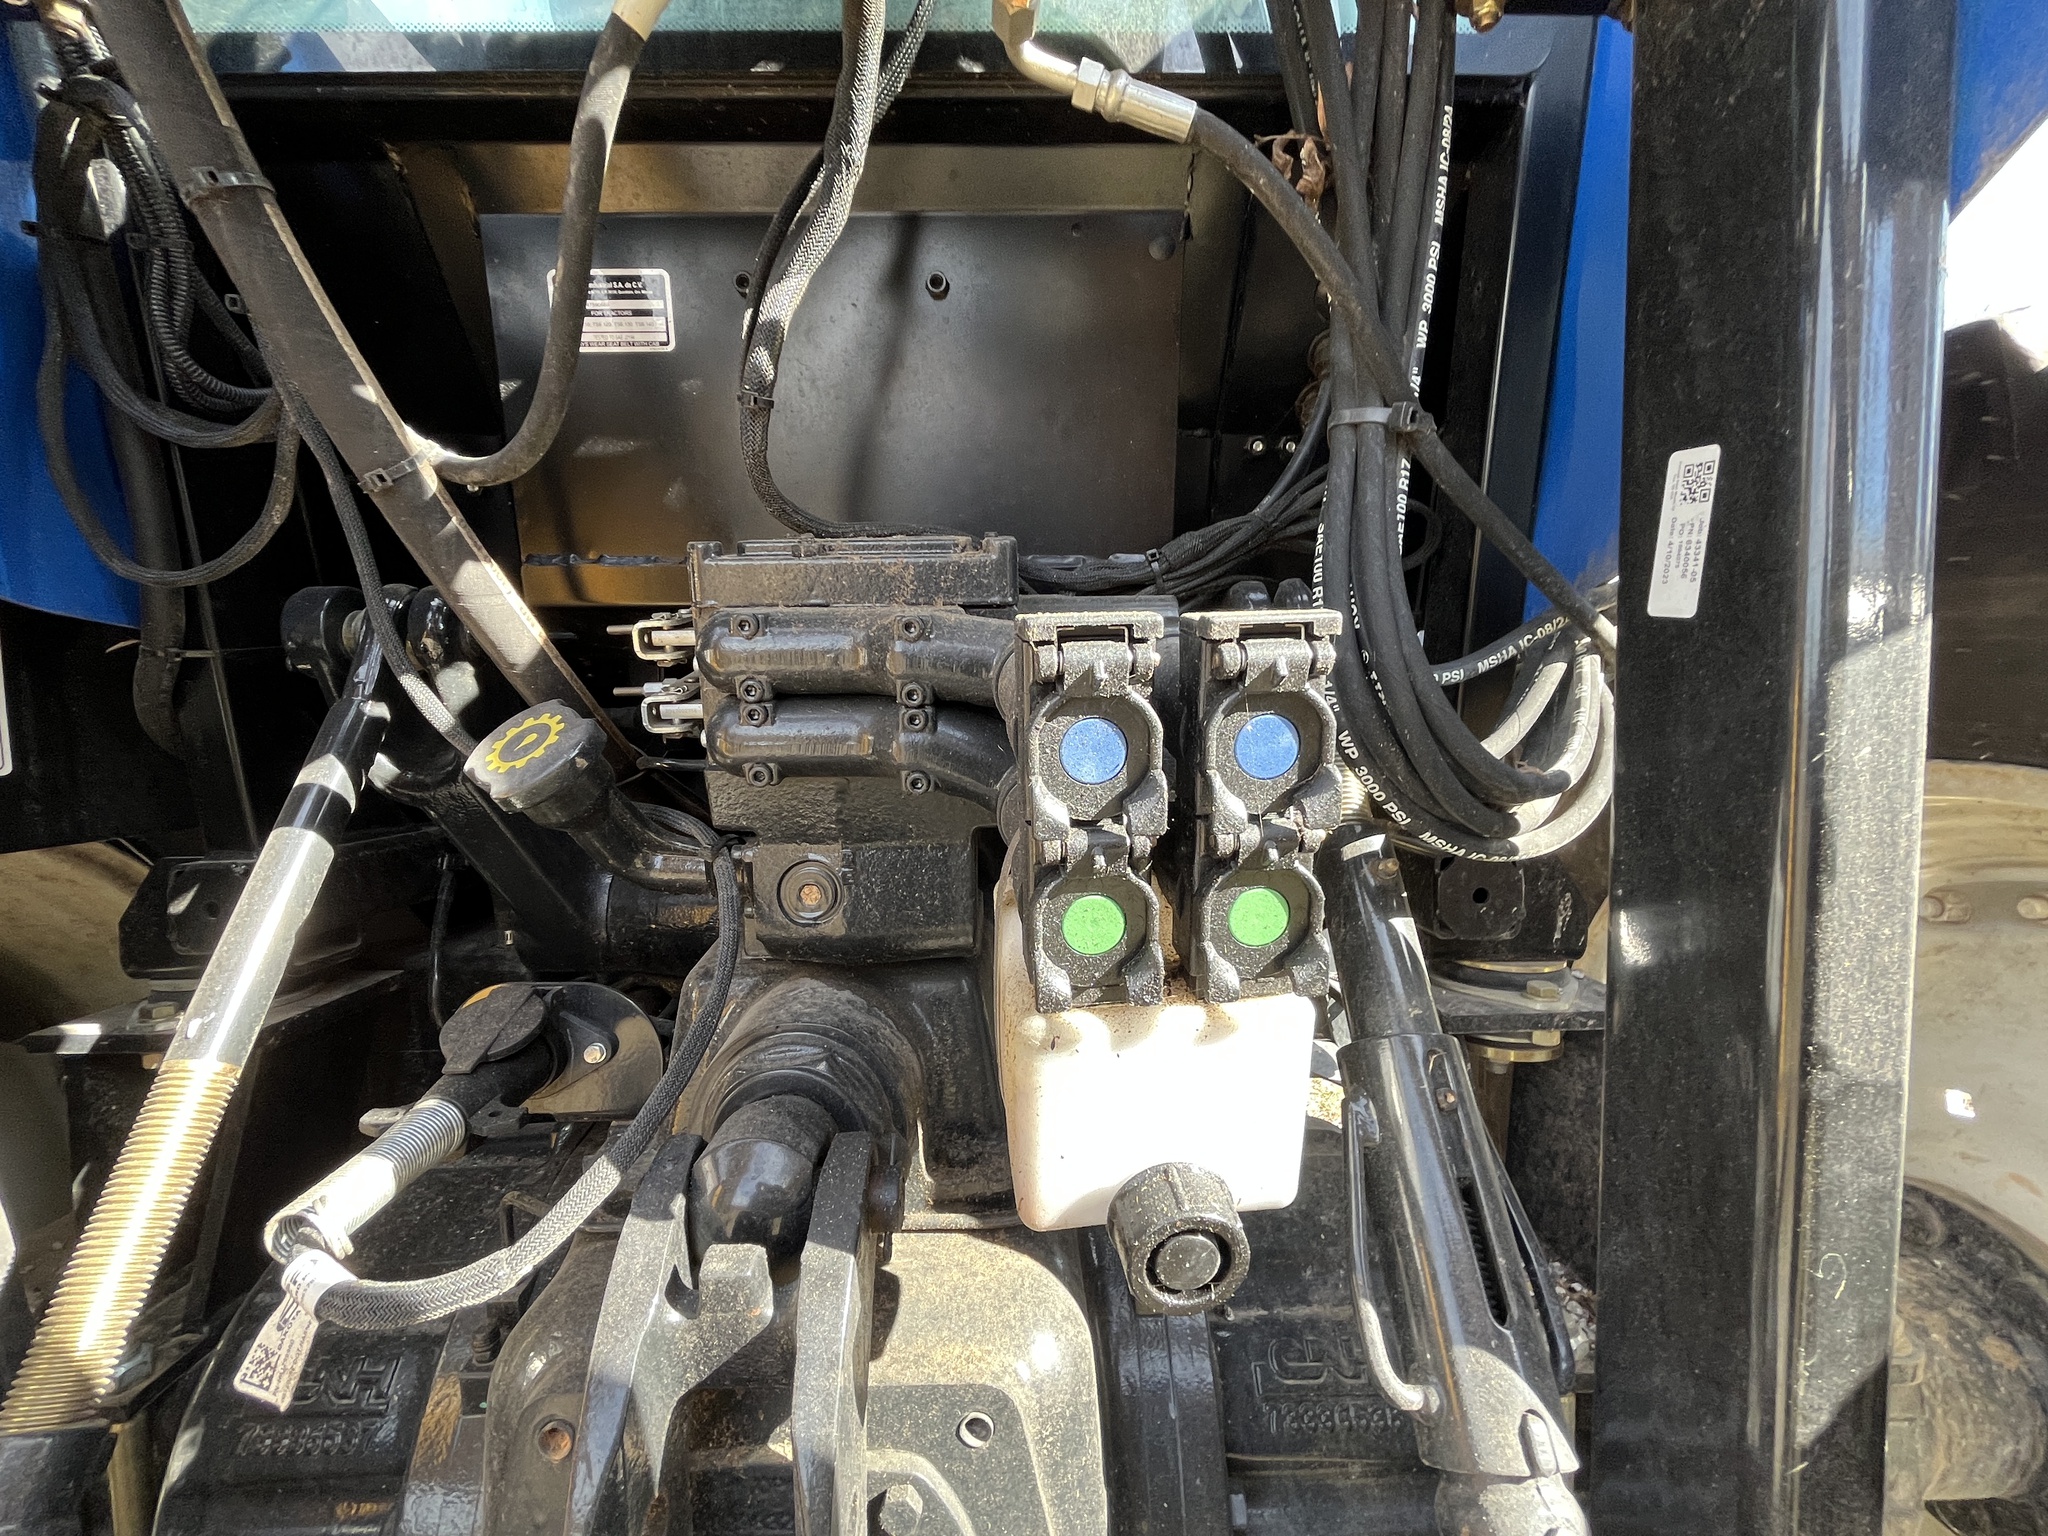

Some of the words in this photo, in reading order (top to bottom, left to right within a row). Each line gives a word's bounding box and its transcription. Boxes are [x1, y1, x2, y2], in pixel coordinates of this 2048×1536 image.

[1434, 175, 1448, 227] MSHA
[1427, 240, 1441, 272] PSI
[1421, 272, 1436, 315] 3000
[1415, 319, 1429, 349] WP
[1399, 457, 1411, 492] R17
[1396, 493, 1408, 555] E100
[1669, 517, 1678, 539] Date:
[1662, 540, 1674, 585] 4/10/2023
[1690, 539, 1702, 583] 43341-05
[1441, 668, 1465, 684] PSI
[1477, 644, 1518, 674] MSHA
[1312, 588, 1324, 609] R1
[1323, 680, 1340, 712] 1/4"
[1337, 729, 1360, 760] WP
[1354, 765, 1387, 802] 3000
[1382, 801, 1413, 826] PSI
[1418, 830, 1465, 858] MSHA
[277, 1309, 302, 1351] DAKOTA
